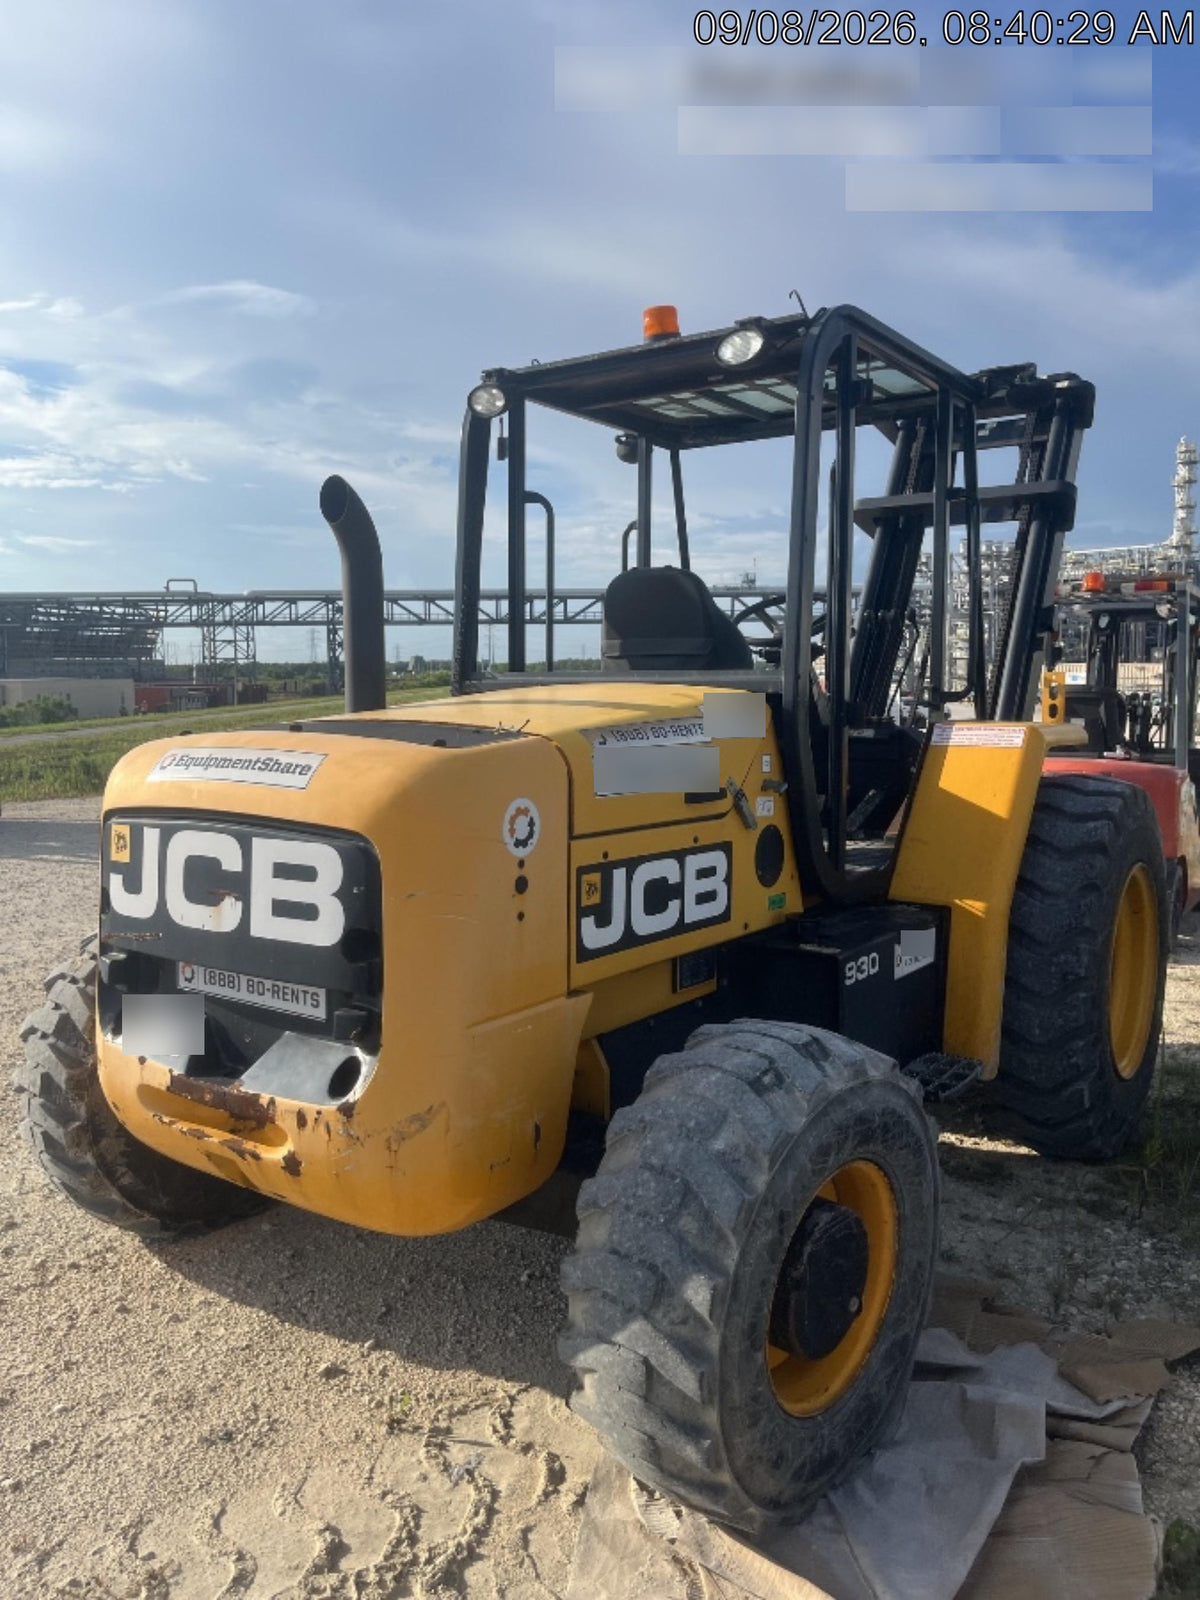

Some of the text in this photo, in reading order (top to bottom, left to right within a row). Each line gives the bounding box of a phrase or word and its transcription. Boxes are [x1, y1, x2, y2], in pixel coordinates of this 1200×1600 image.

[174, 753, 313, 776] EquipmentShare
[109, 826, 346, 947] JCB
[580, 850, 729, 950] JCB
[203, 968, 321, 1009] (888) 80-RENTS
[844, 952, 880, 986] 930
